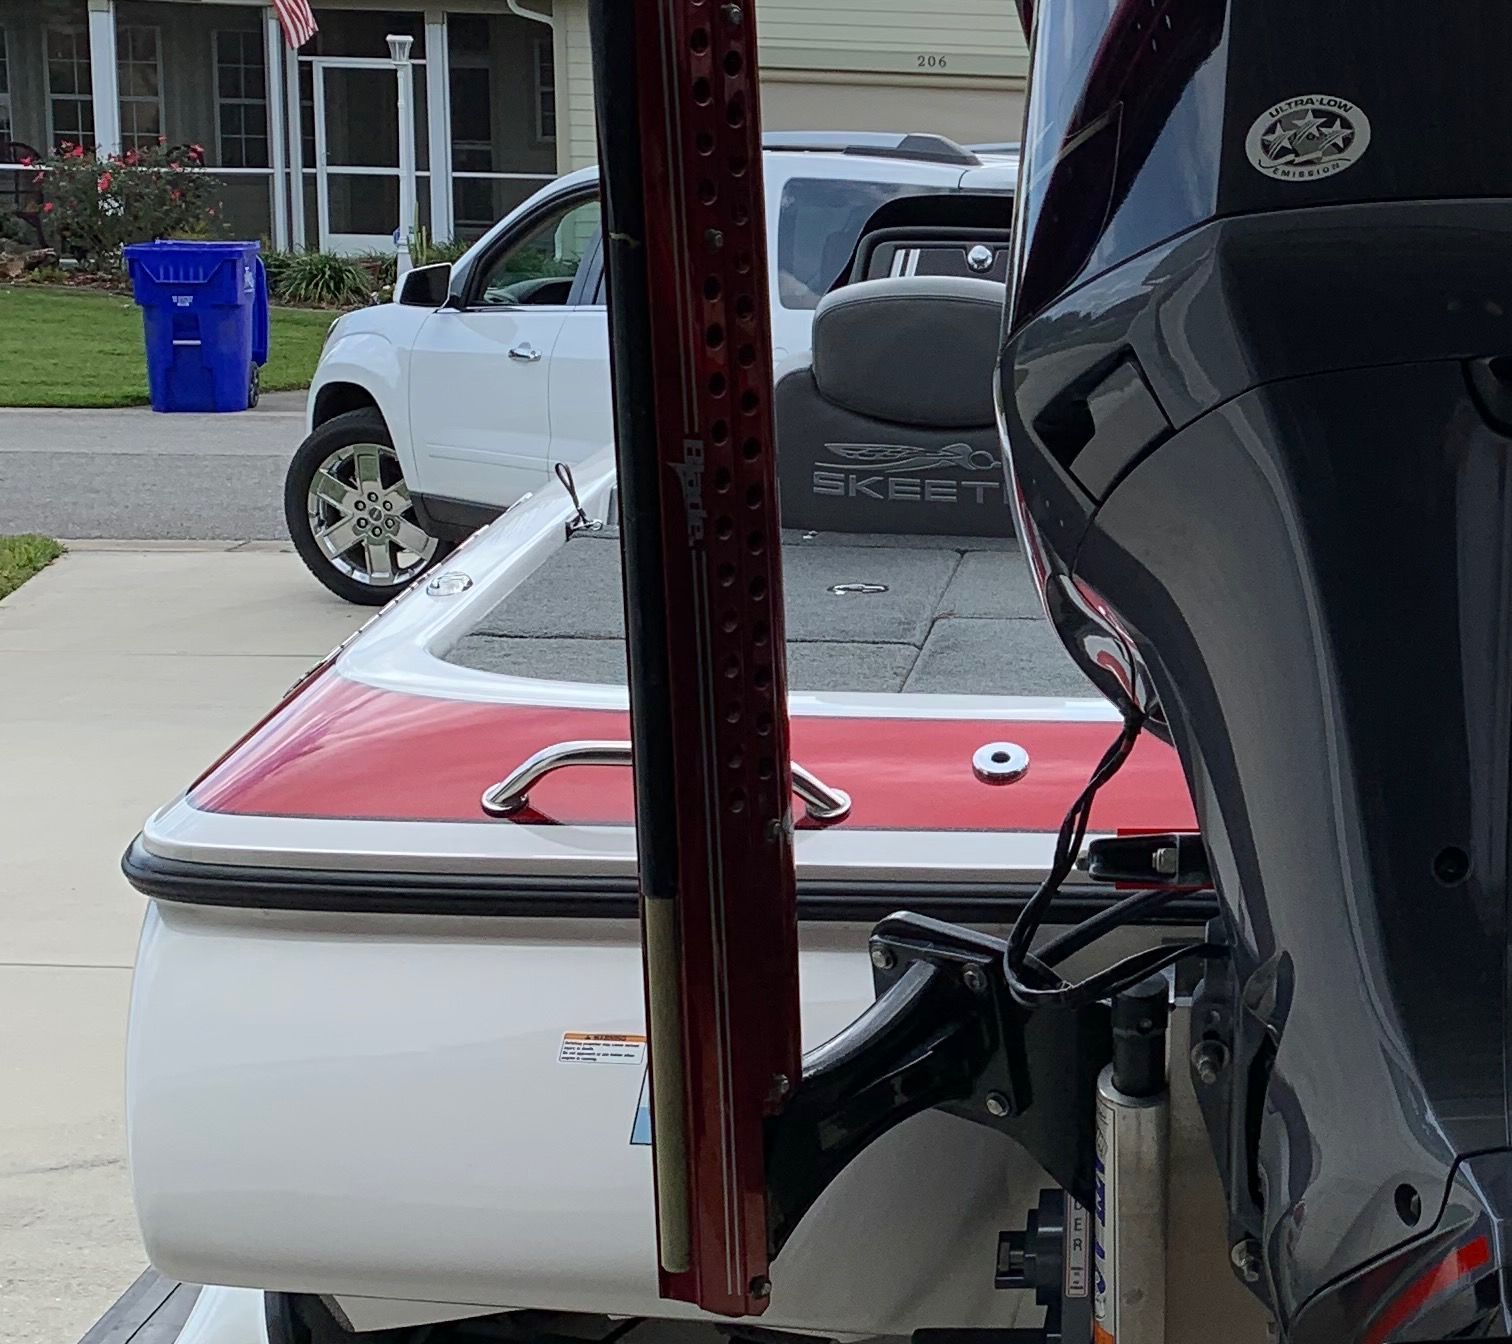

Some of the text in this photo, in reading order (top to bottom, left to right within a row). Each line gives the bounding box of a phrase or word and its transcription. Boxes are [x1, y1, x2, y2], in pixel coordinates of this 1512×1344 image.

[917, 55, 947, 68] 206
[1272, 162, 1341, 179] EMISSION
[813, 471, 1009, 505] SKEET
